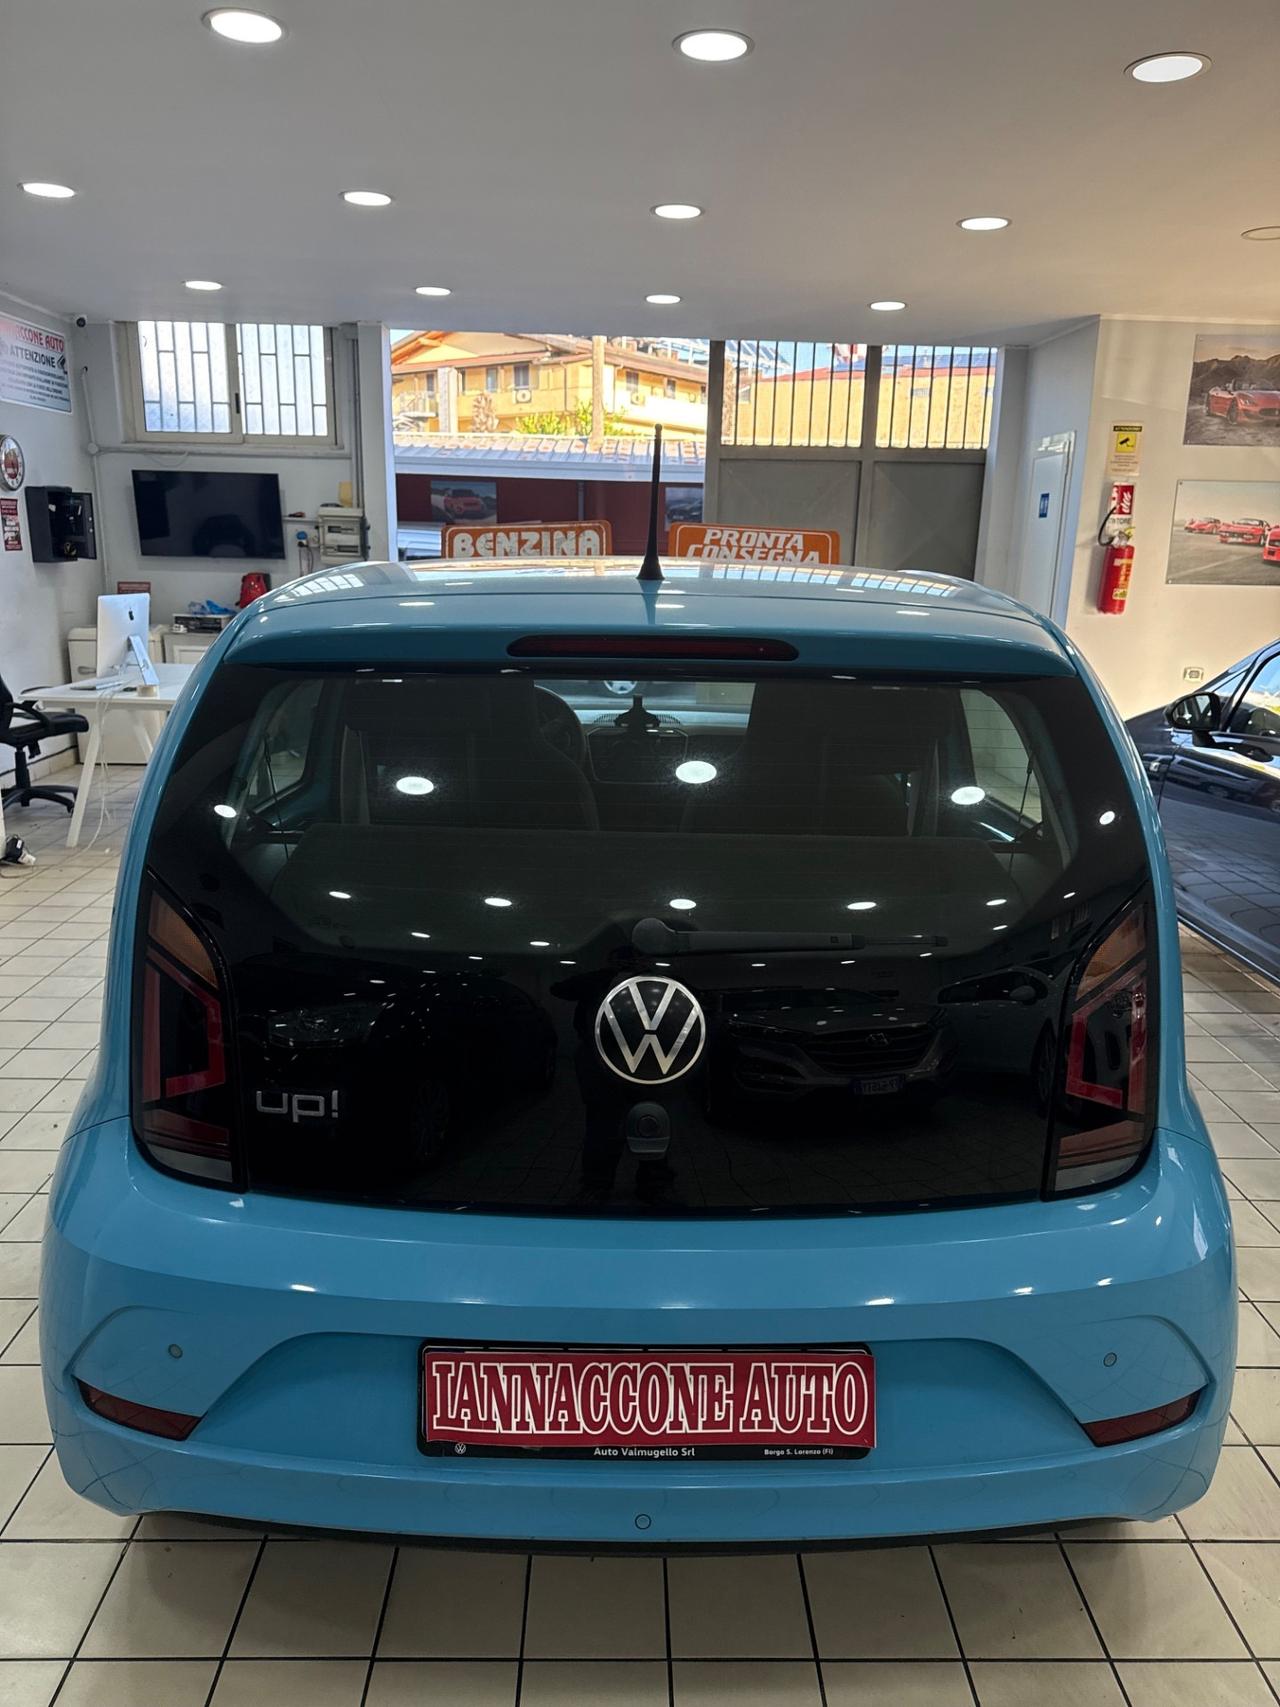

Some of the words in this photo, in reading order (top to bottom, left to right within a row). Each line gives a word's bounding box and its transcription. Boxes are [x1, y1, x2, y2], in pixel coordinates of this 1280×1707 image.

[45, 335, 64, 353] AUTO
[10, 345, 56, 369] ATTENZIONE
[453, 530, 600, 558] BENZINA
[704, 528, 804, 550] PRONTA
[686, 544, 821, 564] CONSEGNA
[256, 1090, 339, 1123] up!
[432, 1361, 734, 1435] IANNACCONE
[739, 1361, 869, 1436] AUTO
[593, 1447, 618, 1456] Auto
[681, 1447, 695, 1456] Srl
[764, 1448, 785, 1457] Borgo
